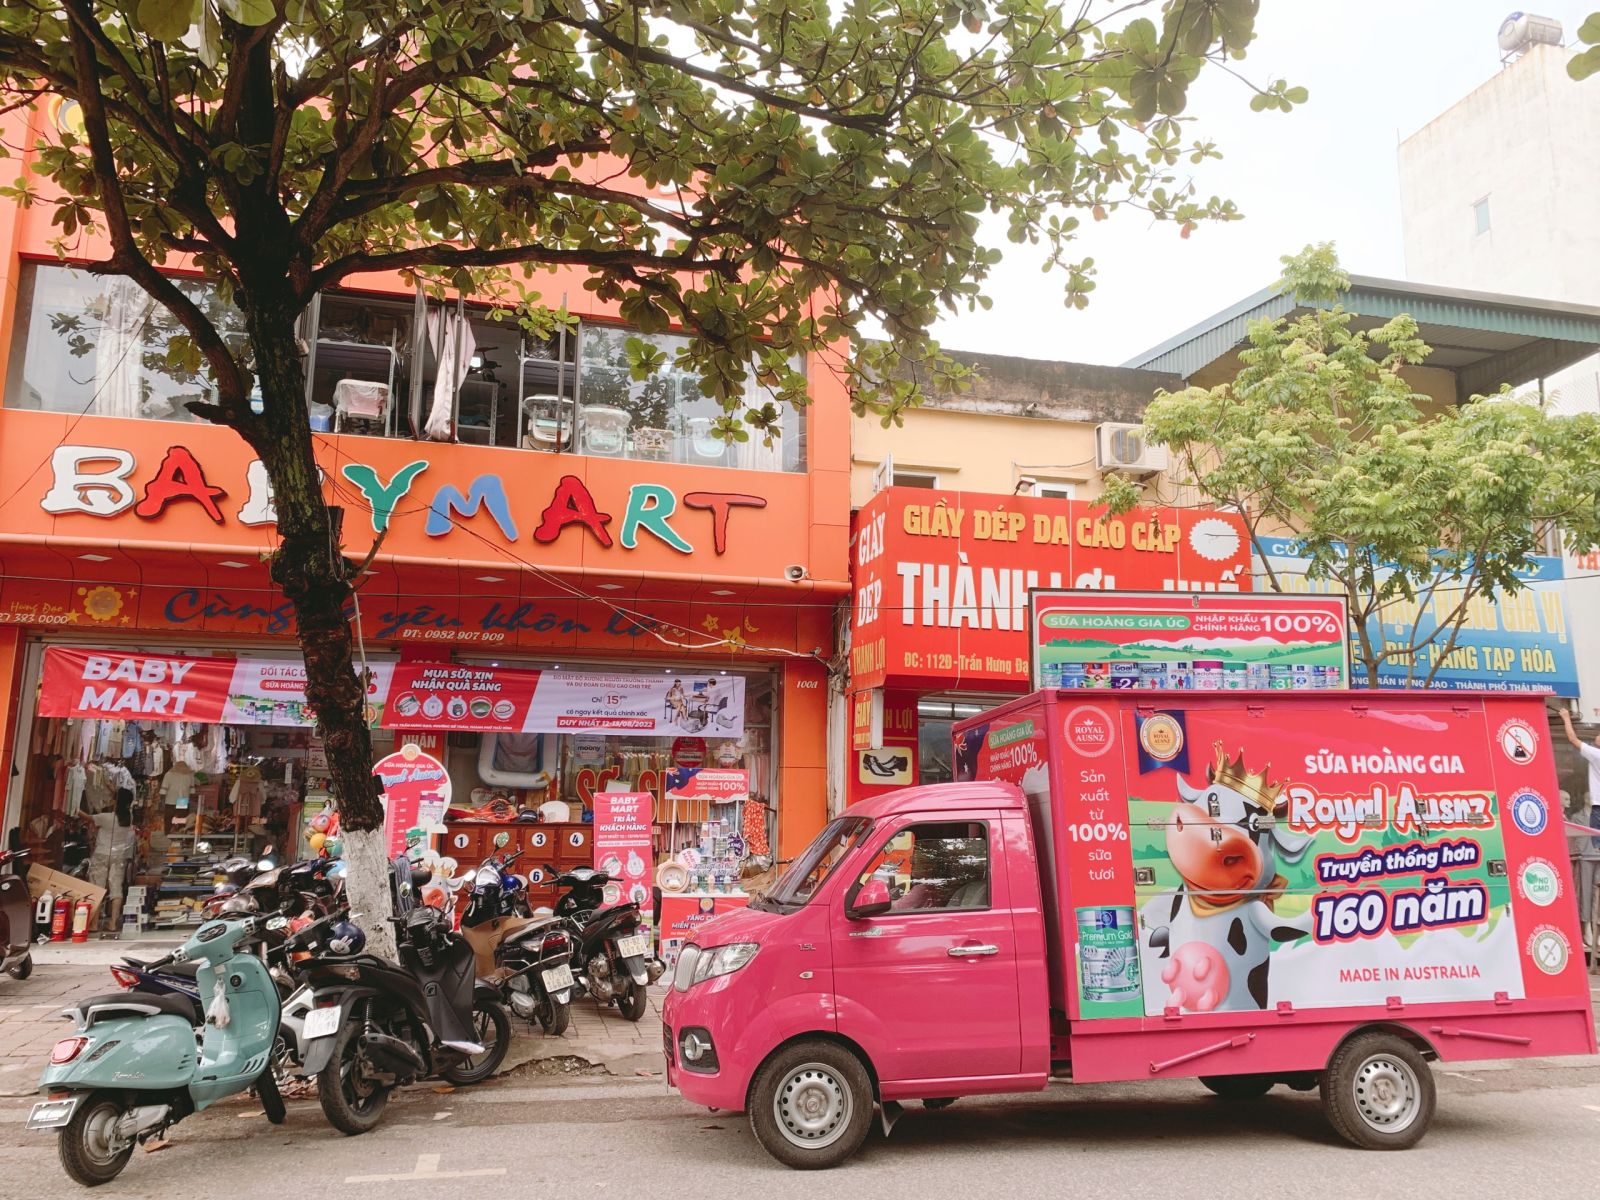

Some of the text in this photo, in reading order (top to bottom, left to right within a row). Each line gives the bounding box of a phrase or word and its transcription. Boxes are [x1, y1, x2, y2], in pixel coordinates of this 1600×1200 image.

[1076, 517, 1126, 550] CAO
[897, 552, 1038, 632] THÀNH
[1050, 615, 1185, 628] SỮA HOÀNG GIA ÚC
[1195, 615, 1226, 625] NHẬP
[1260, 615, 1337, 633] 100%
[1193, 623, 1227, 632] CHÍNH
[425, 629, 454, 640] 0982
[457, 631, 479, 641] 907
[482, 632, 505, 642] 909
[1015, 657, 1029, 676] Đạ
[1482, 646, 1515, 677] TẠP
[1520, 644, 1557, 673] HÓA
[81, 655, 197, 685] BABY
[423, 669, 449, 679] MUA
[450, 669, 473, 680] SỮA
[411, 678, 445, 692] NHẬN
[446, 679, 470, 692] QUÀ
[1120, 678, 1132, 690] 2
[1455, 680, 1487, 691] THÀNH
[78, 686, 197, 715] MART
[607, 695, 619, 704] 15
[1075, 725, 1104, 734] ROYAL
[1076, 734, 1105, 743] AUSNZ
[577, 745, 601, 753] moony
[1010, 742, 1038, 768] 100%
[1304, 747, 1466, 774] SỮA HOÀNG GIA
[1080, 770, 1106, 784] Sản
[719, 782, 746, 792] 100%
[610, 796, 638, 804] BABY
[1080, 788, 1110, 801] xuất
[610, 805, 639, 813] MART
[1089, 807, 1105, 820] từ
[1287, 785, 1384, 839] Royal
[1396, 785, 1491, 829] Ausnz
[599, 823, 647, 832] KHÁCH HÀNG
[1068, 823, 1128, 842] 100%
[458, 836, 464, 847] 1
[536, 834, 543, 845] 3
[572, 834, 579, 845] 4
[1088, 848, 1112, 861] sữa
[1320, 845, 1476, 880] Truyền thống hơn
[533, 871, 540, 882] 6
[1088, 867, 1115, 881] tươi
[1317, 894, 1385, 938] 160
[1394, 881, 1484, 927] năm
[1339, 965, 1481, 983] MADE IN AUSTRALIA
